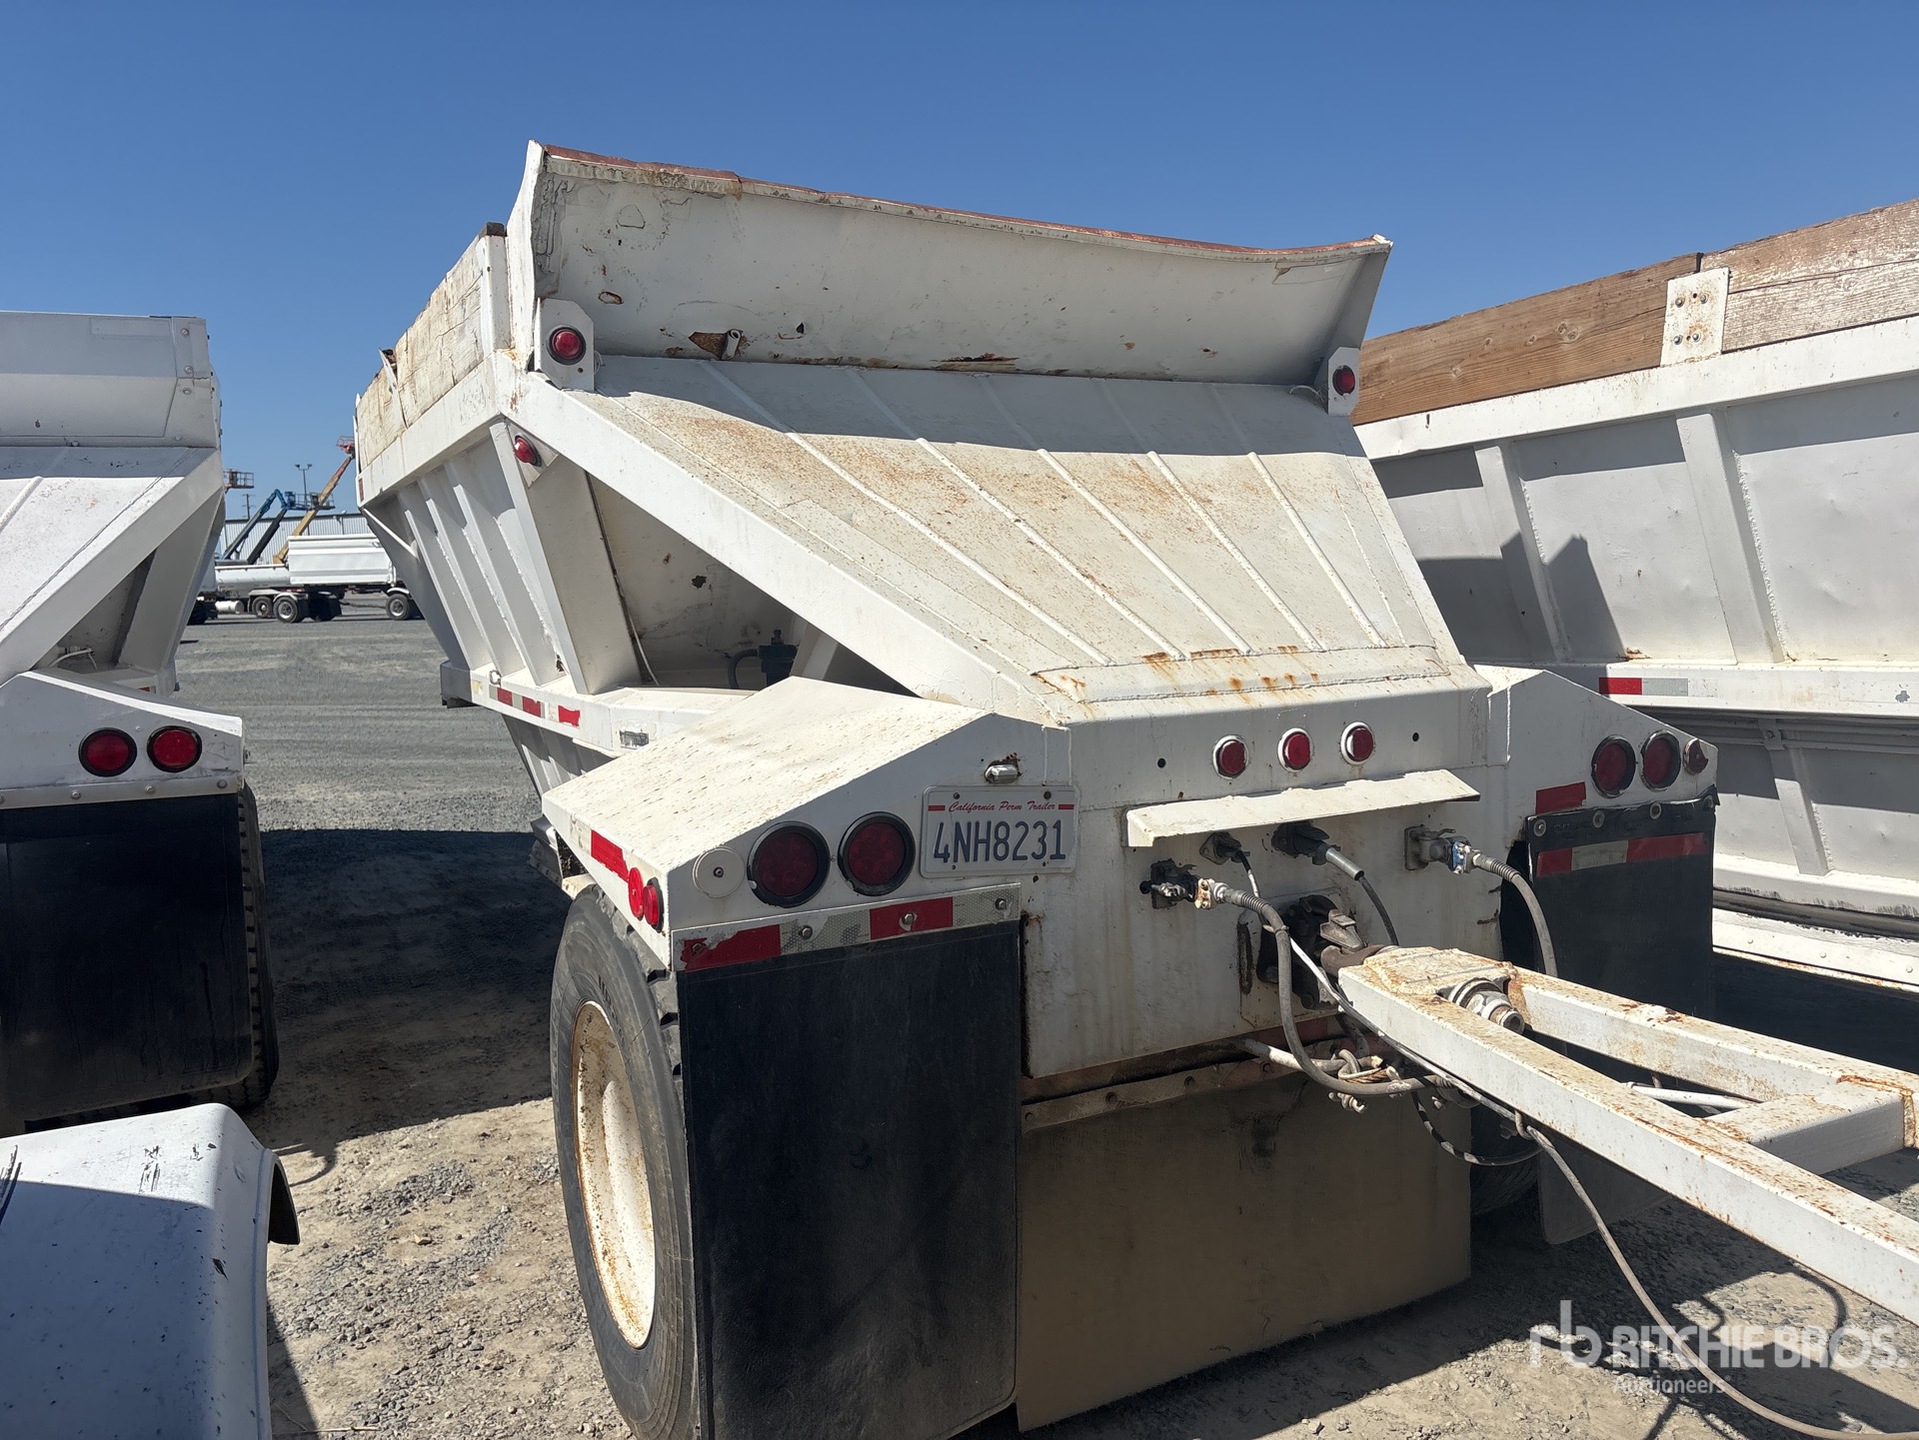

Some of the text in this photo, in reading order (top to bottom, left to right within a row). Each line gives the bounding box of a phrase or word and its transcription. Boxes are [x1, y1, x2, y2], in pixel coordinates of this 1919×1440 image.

[948, 800, 1056, 813] California Perm Trailer
[933, 820, 1066, 863] 4NH8231
